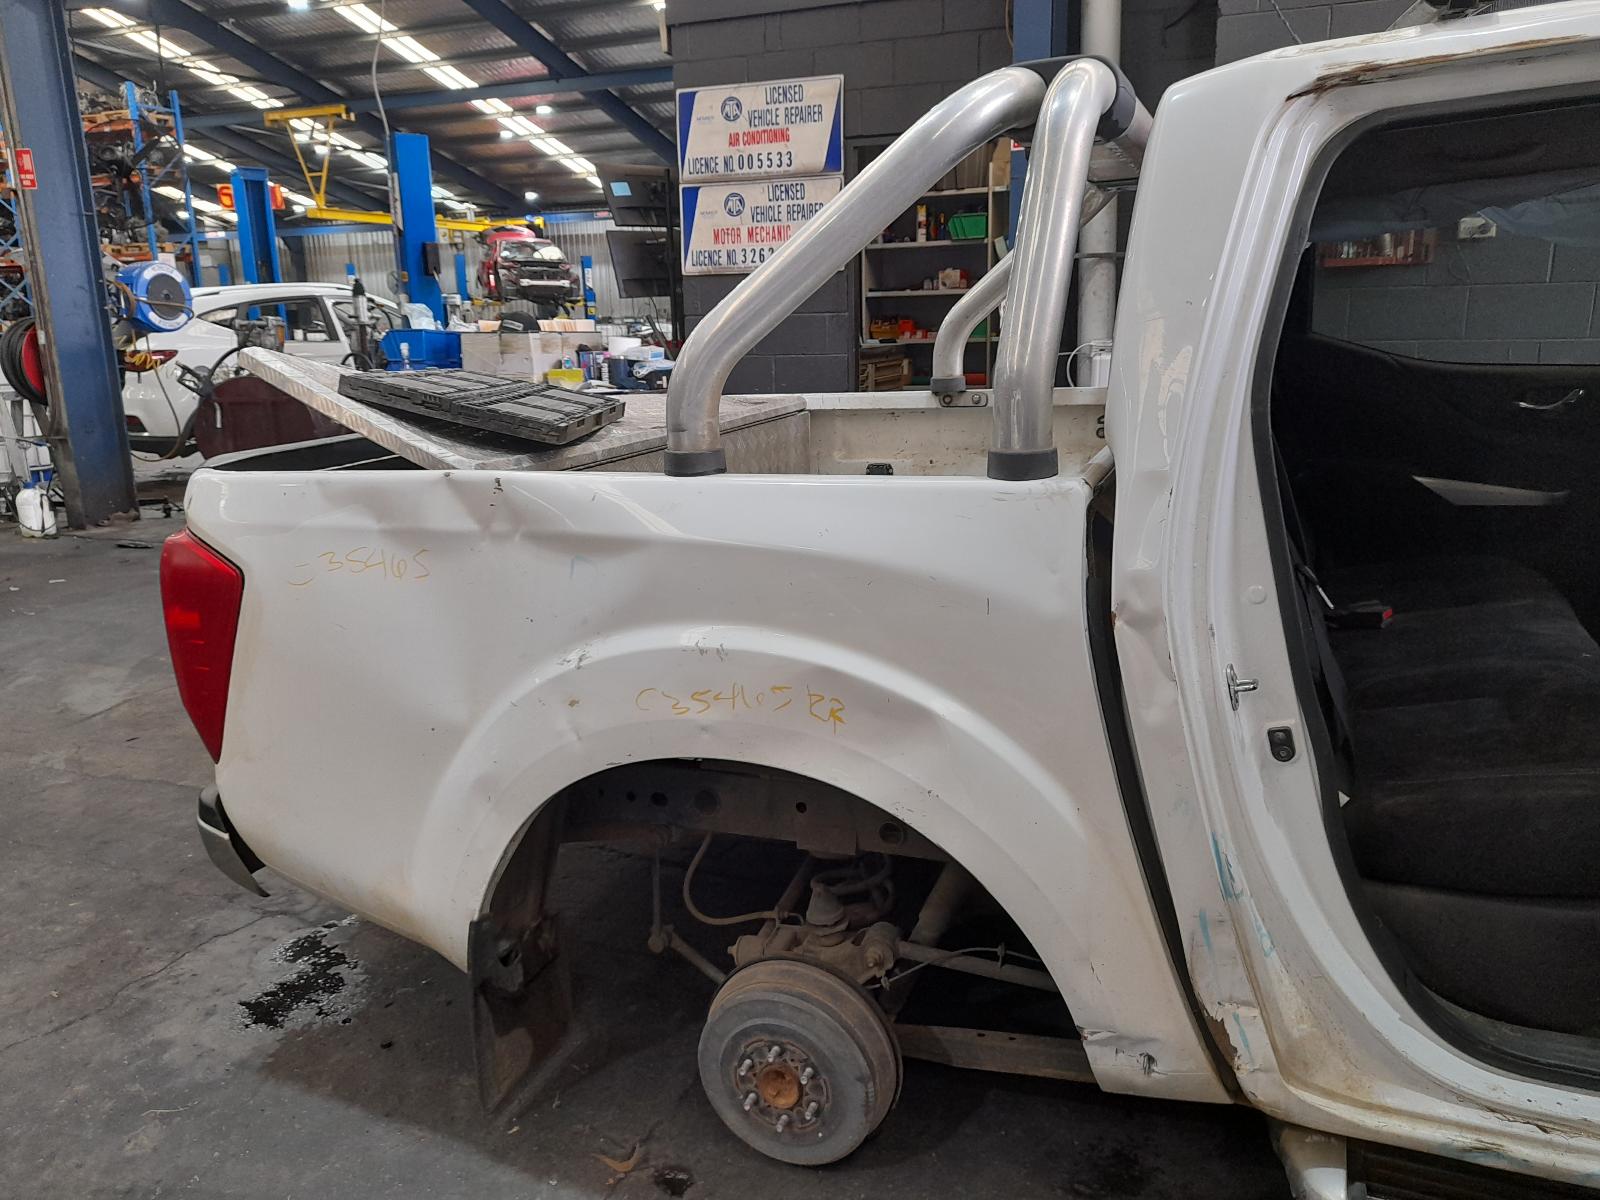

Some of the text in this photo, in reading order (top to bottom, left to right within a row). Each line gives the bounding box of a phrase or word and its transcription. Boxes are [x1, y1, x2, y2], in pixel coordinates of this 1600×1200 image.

[765, 84, 803, 105] LICENSED
[748, 104, 823, 128] VEHICLE REPAIRER
[728, 127, 790, 147] AIR CONDITIONING
[688, 155, 719, 175] LICENCE
[768, 183, 805, 202] LICENSED
[750, 205, 781, 223] VEHICLE
[713, 225, 791, 245] MOTOR MECHANIC
[691, 249, 722, 267] LICENCE
